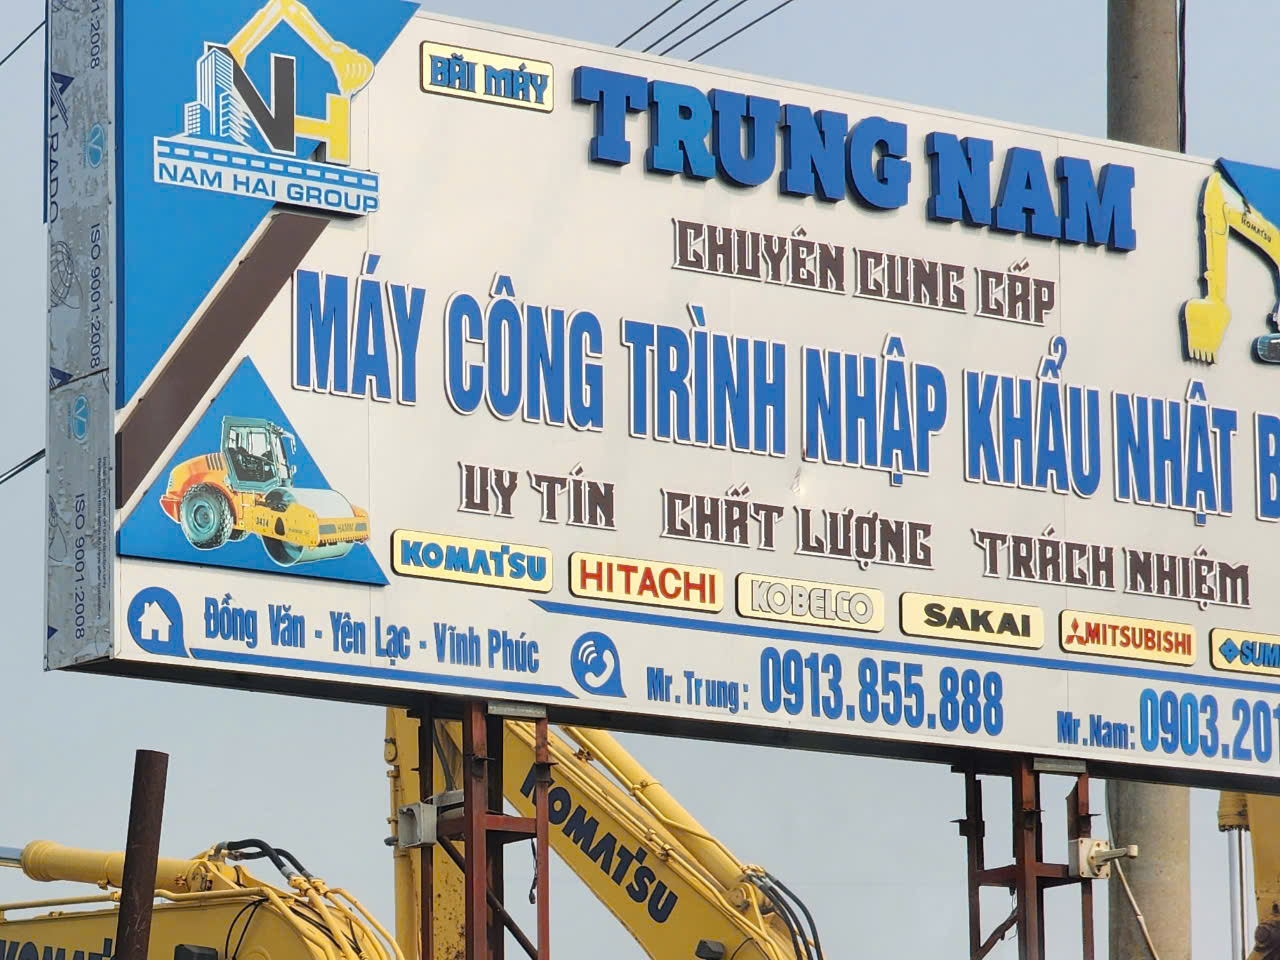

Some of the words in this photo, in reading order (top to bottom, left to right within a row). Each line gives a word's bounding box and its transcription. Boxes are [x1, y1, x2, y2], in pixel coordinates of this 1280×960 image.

[90, 0, 100, 69] 1:2008
[429, 52, 478, 93] BÃI
[483, 62, 550, 105] MÁY
[158, 162, 223, 189] NAM
[233, 173, 276, 198] HAI
[286, 183, 379, 212] GROUP
[573, 65, 910, 211] TRUNG
[926, 131, 1137, 252] NAM
[1240, 215, 1272, 244] KOMATSU
[672, 218, 846, 296] CHUYÊN
[853, 246, 966, 315] CUNG
[975, 258, 1055, 327] CẤP
[292, 251, 426, 405] MÁY
[444, 272, 605, 432] CÔNG
[622, 303, 787, 458] TRÌNH
[803, 333, 948, 487] NHẬP
[963, 336, 1102, 499] KHẨU
[1113, 379, 1238, 526] NHẬT
[75, 493, 85, 530] ISO
[458, 461, 519, 518] UY
[529, 463, 618, 531] TÍN
[660, 483, 784, 551] CHẤT
[796, 506, 934, 570] LƯỢNG
[75, 537, 86, 640] 9001:2008
[401, 540, 547, 581] KOMATSU
[580, 556, 717, 605] HITACHI
[972, 525, 1116, 592] TRÁCH
[1123, 545, 1251, 610] NHIỆM
[204, 593, 258, 648] Đồng
[268, 603, 306, 647] Văn
[329, 610, 366, 655] Yên
[374, 616, 411, 666] Lạc
[434, 627, 481, 667] Vĩnh
[488, 631, 540, 674] Phúc
[750, 579, 875, 624] KOBELCO
[923, 602, 1032, 638] SAKAI
[1085, 621, 1192, 656] MITSUBISHI
[759, 647, 1005, 736] 0913.855.888
